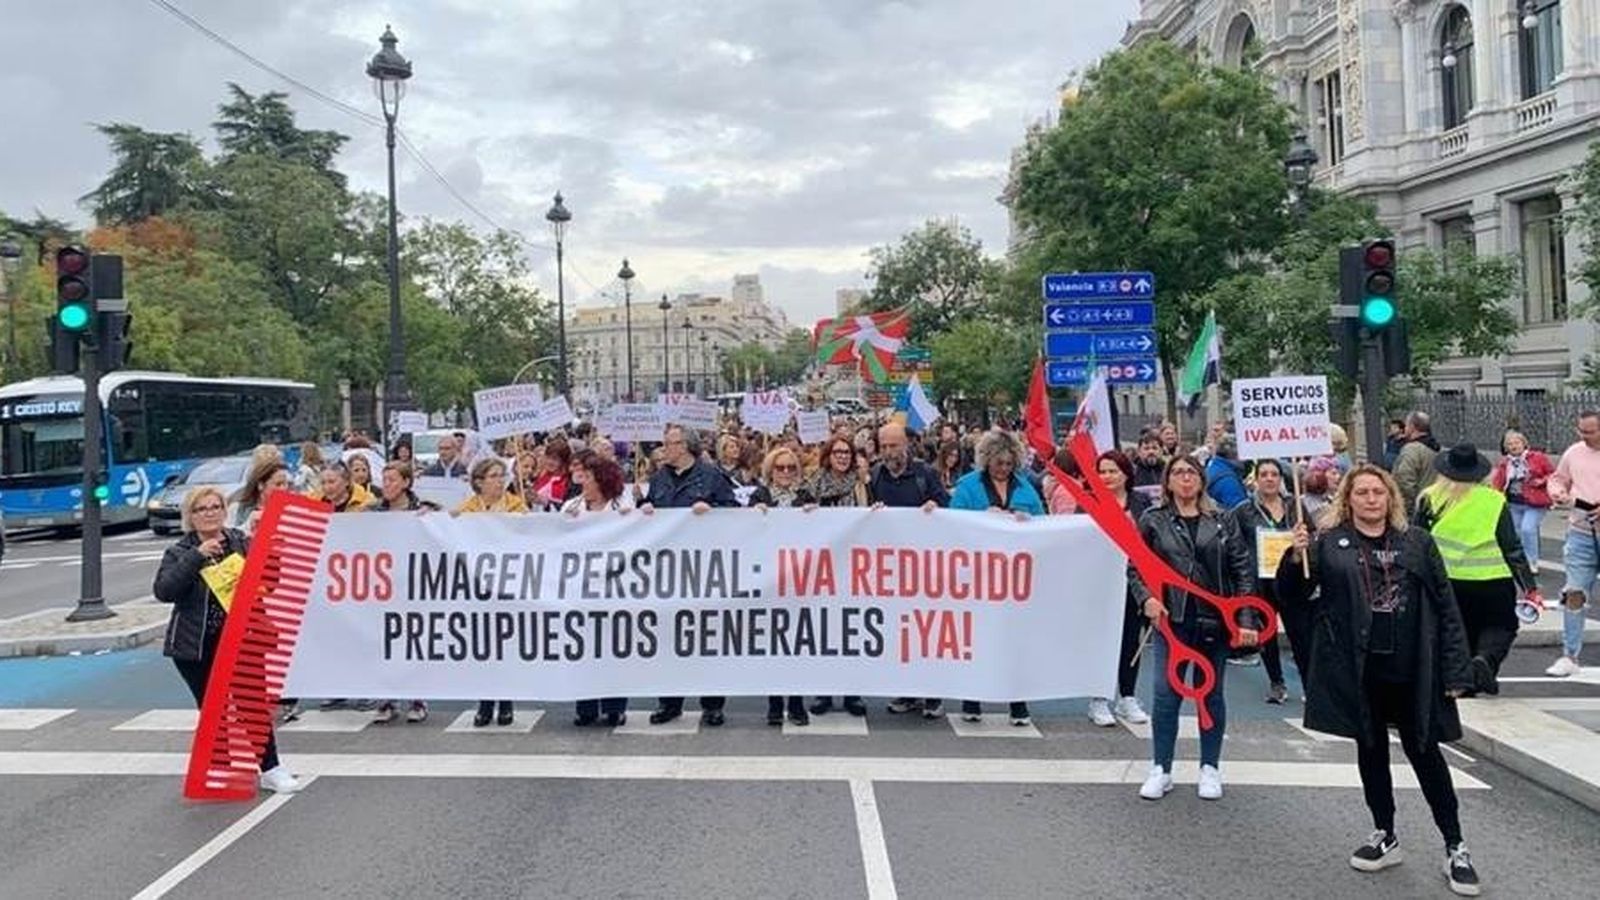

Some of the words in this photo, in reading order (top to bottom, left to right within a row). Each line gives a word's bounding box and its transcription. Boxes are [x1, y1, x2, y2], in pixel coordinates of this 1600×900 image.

[1048, 281, 1094, 292] Valencia
[753, 393, 783, 406] IVA
[1241, 385, 1324, 402] SERVICIOS
[2, 405, 12, 418] 1
[15, 402, 56, 415] CRISTO
[1242, 402, 1326, 418] ESENCIALES
[1244, 428, 1273, 442] IVA
[1278, 427, 1300, 440] AL
[1304, 426, 1328, 439] 10%
[326, 552, 394, 601] SOS
[407, 552, 545, 600] IMAGEN
[558, 549, 762, 599] PERSONAL:
[777, 549, 836, 597] IVA
[851, 548, 1033, 601] REDUCIDO
[384, 609, 658, 661] PRESUPUESTOS
[674, 607, 885, 658] GENERALES
[901, 609, 973, 663] ¡YA!
